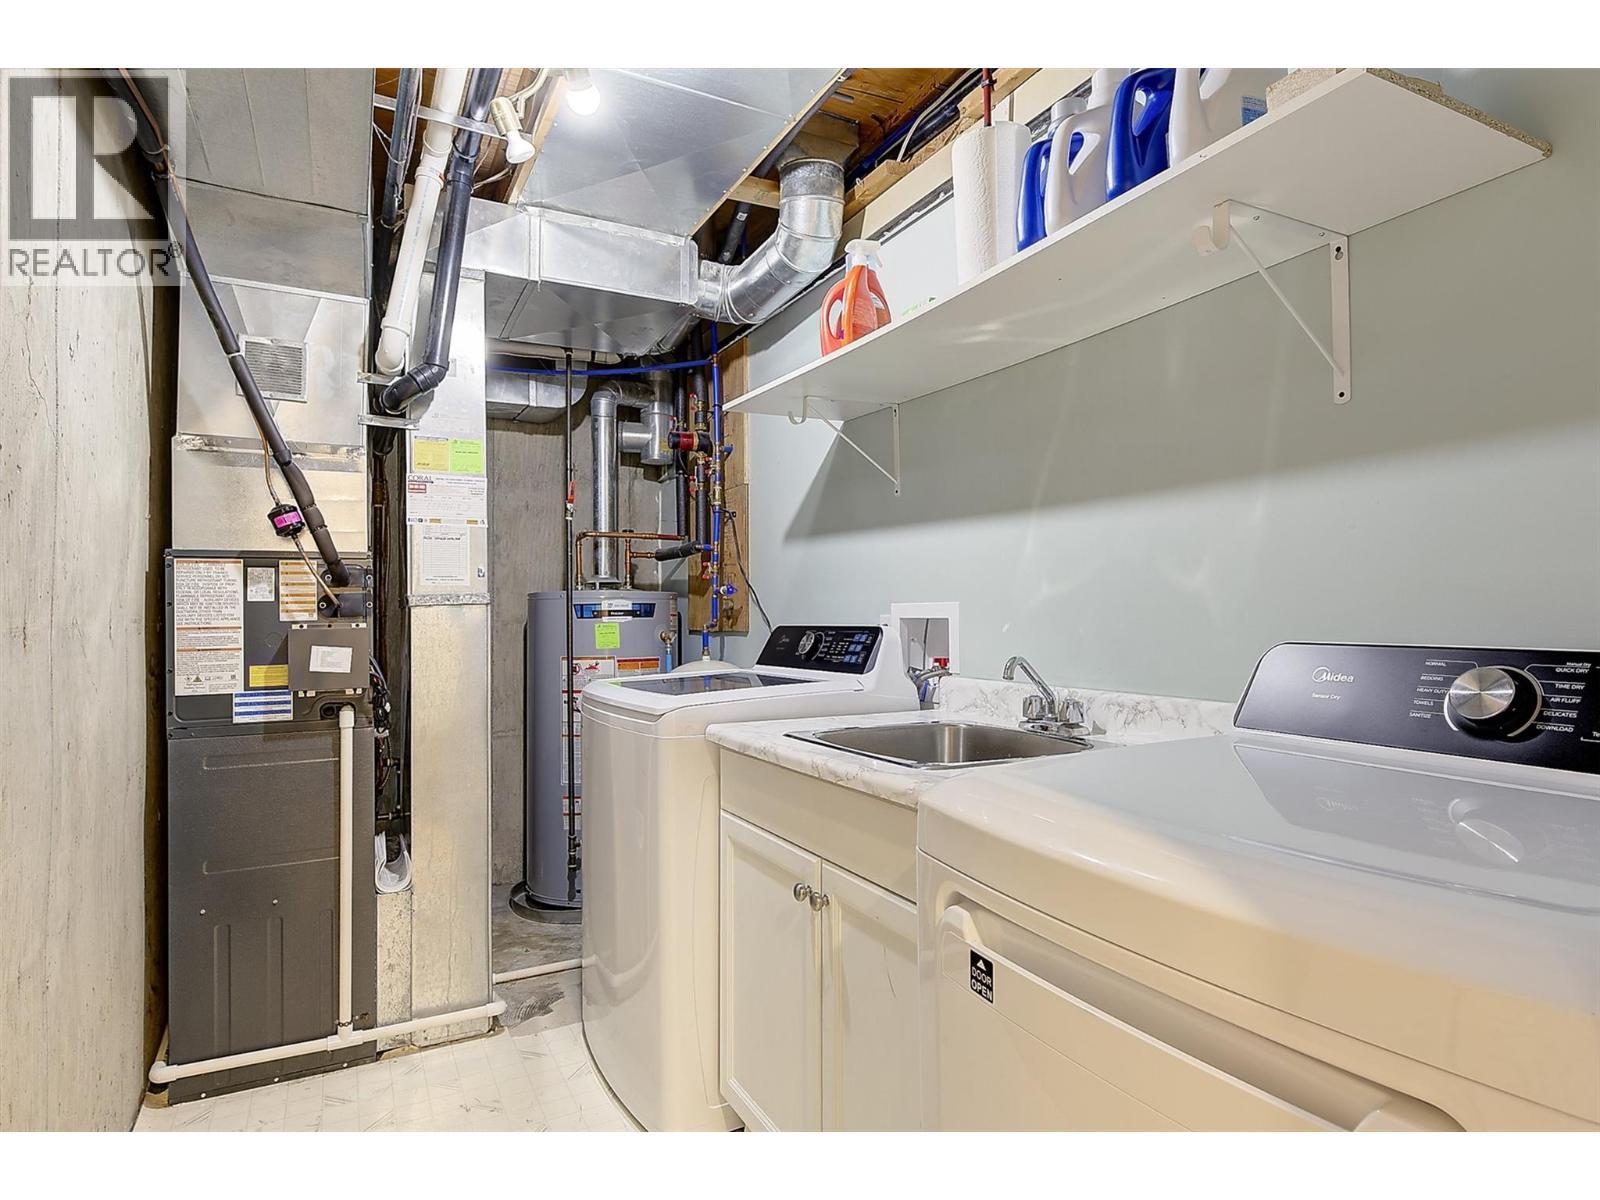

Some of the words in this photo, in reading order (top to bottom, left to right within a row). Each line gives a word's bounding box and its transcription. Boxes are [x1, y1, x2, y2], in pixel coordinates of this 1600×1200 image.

[1312, 666, 1354, 683] Midea
[1536, 724, 1574, 732] DOWNLOAD
[972, 966, 992, 987] DOOR
[972, 979, 992, 1001] OPEN
